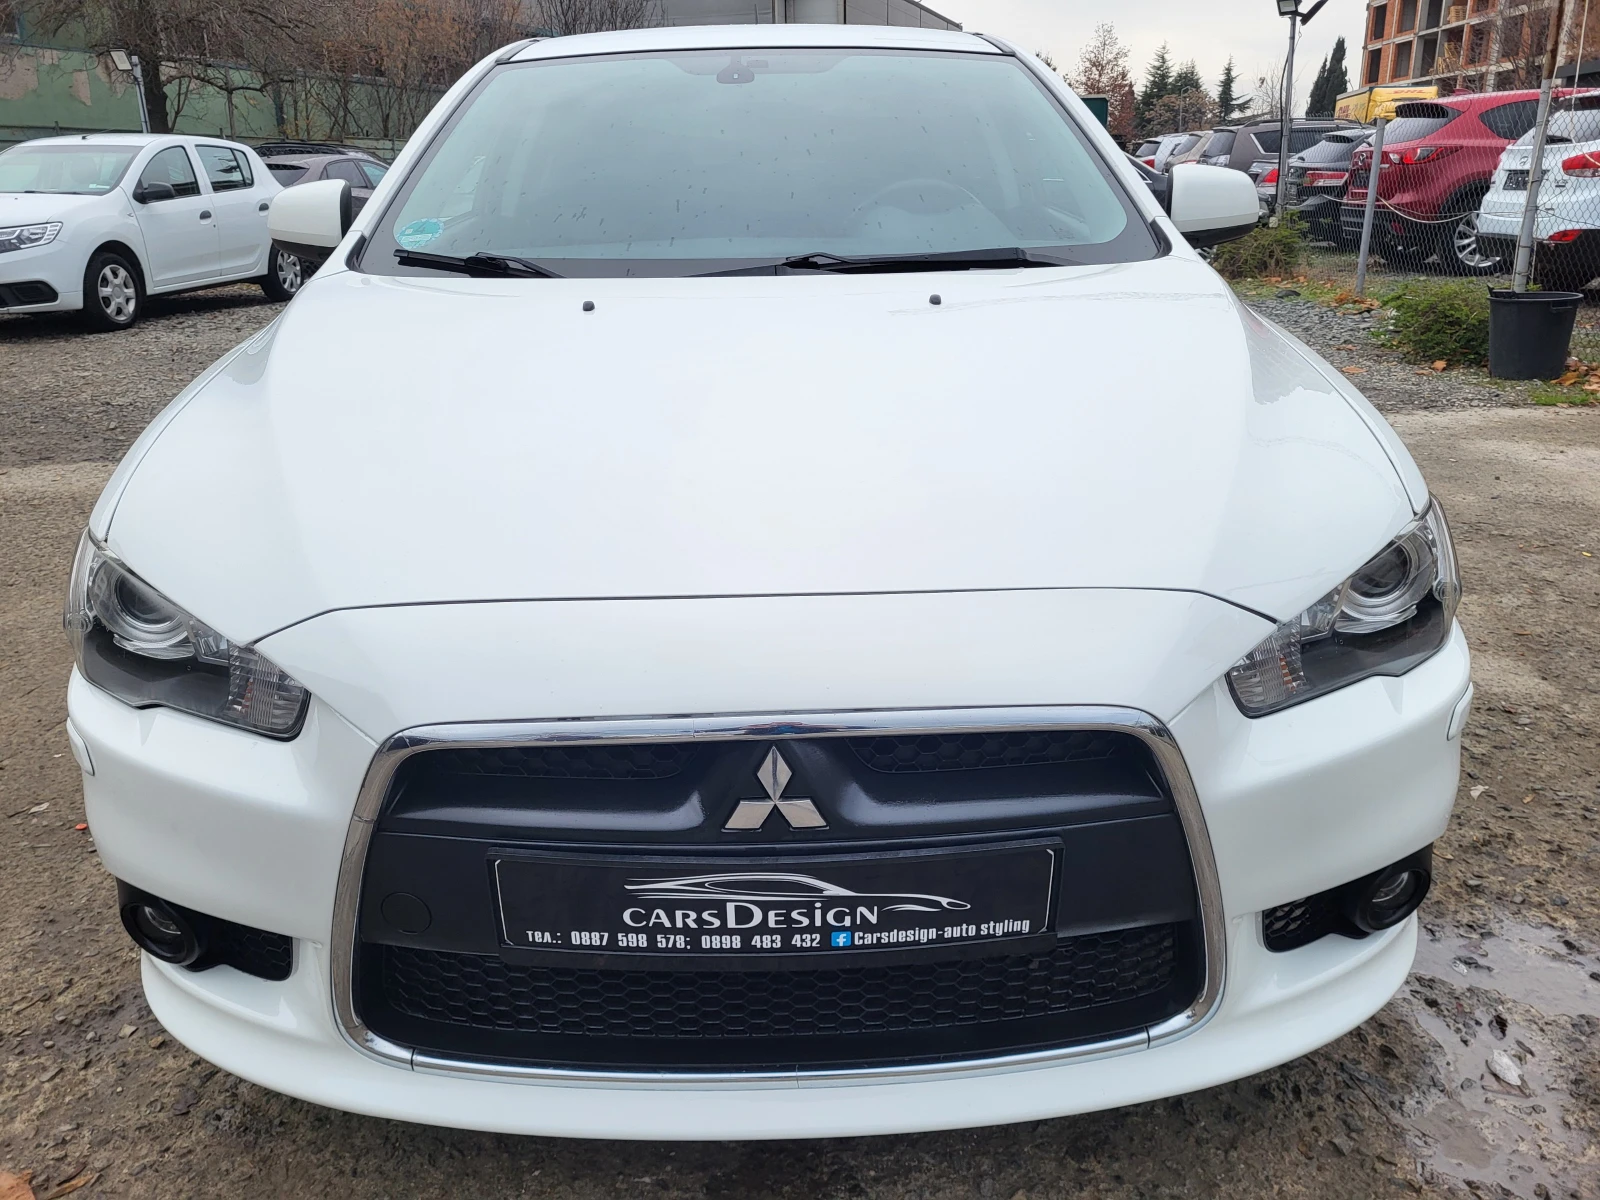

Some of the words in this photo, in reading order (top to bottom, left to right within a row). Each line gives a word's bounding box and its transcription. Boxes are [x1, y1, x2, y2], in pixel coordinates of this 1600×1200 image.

[570, 930, 609, 946] 0887
[617, 932, 648, 948] 598
[701, 935, 741, 949] 0898
[750, 935, 782, 949] 483
[791, 933, 821, 948] 432
[854, 923, 977, 946] Carsdesign-auto
[980, 919, 1030, 936] styling
